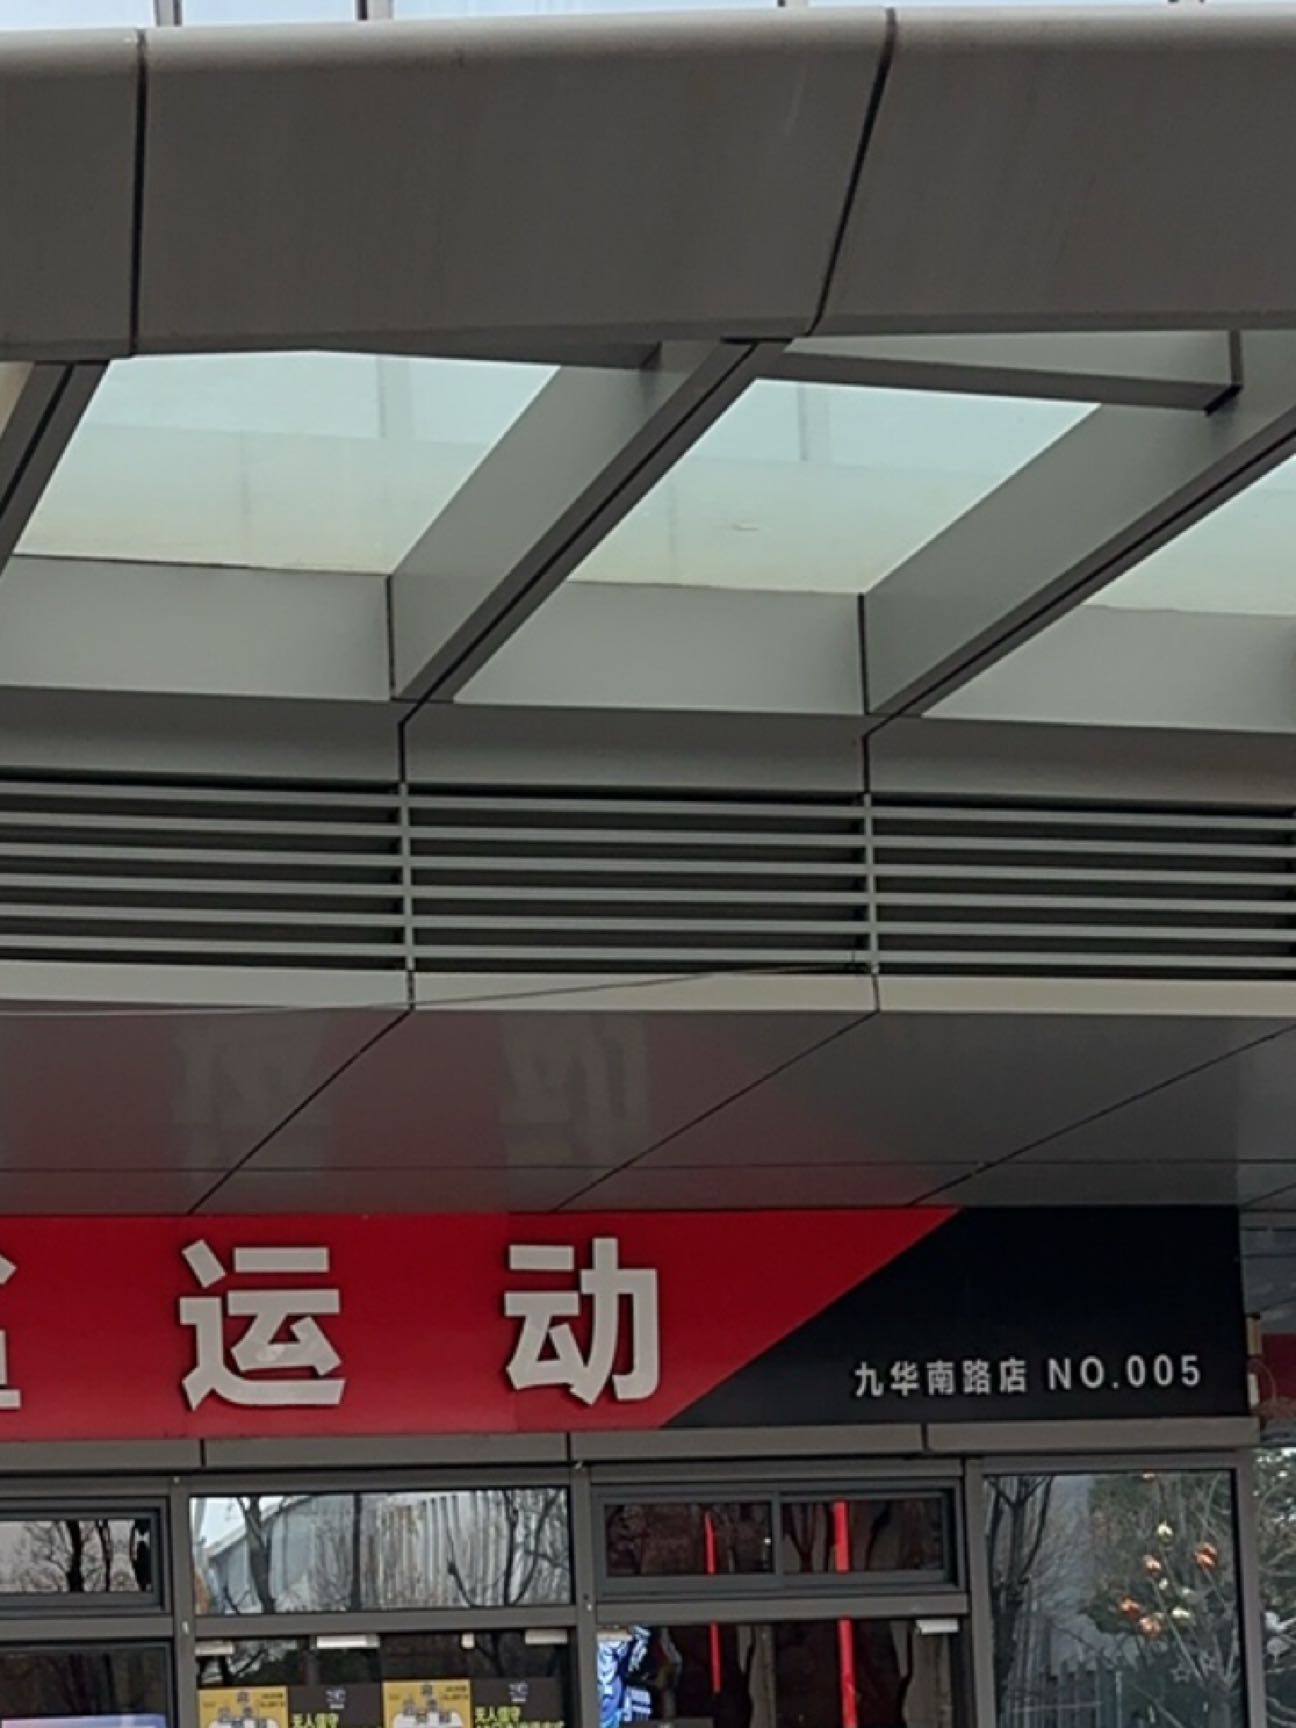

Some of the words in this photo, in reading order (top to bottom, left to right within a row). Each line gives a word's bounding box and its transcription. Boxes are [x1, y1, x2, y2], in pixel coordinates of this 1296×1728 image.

[855, 1358, 1028, 1397] 九华南路店
[1048, 1354, 1202, 1390] NO.005
